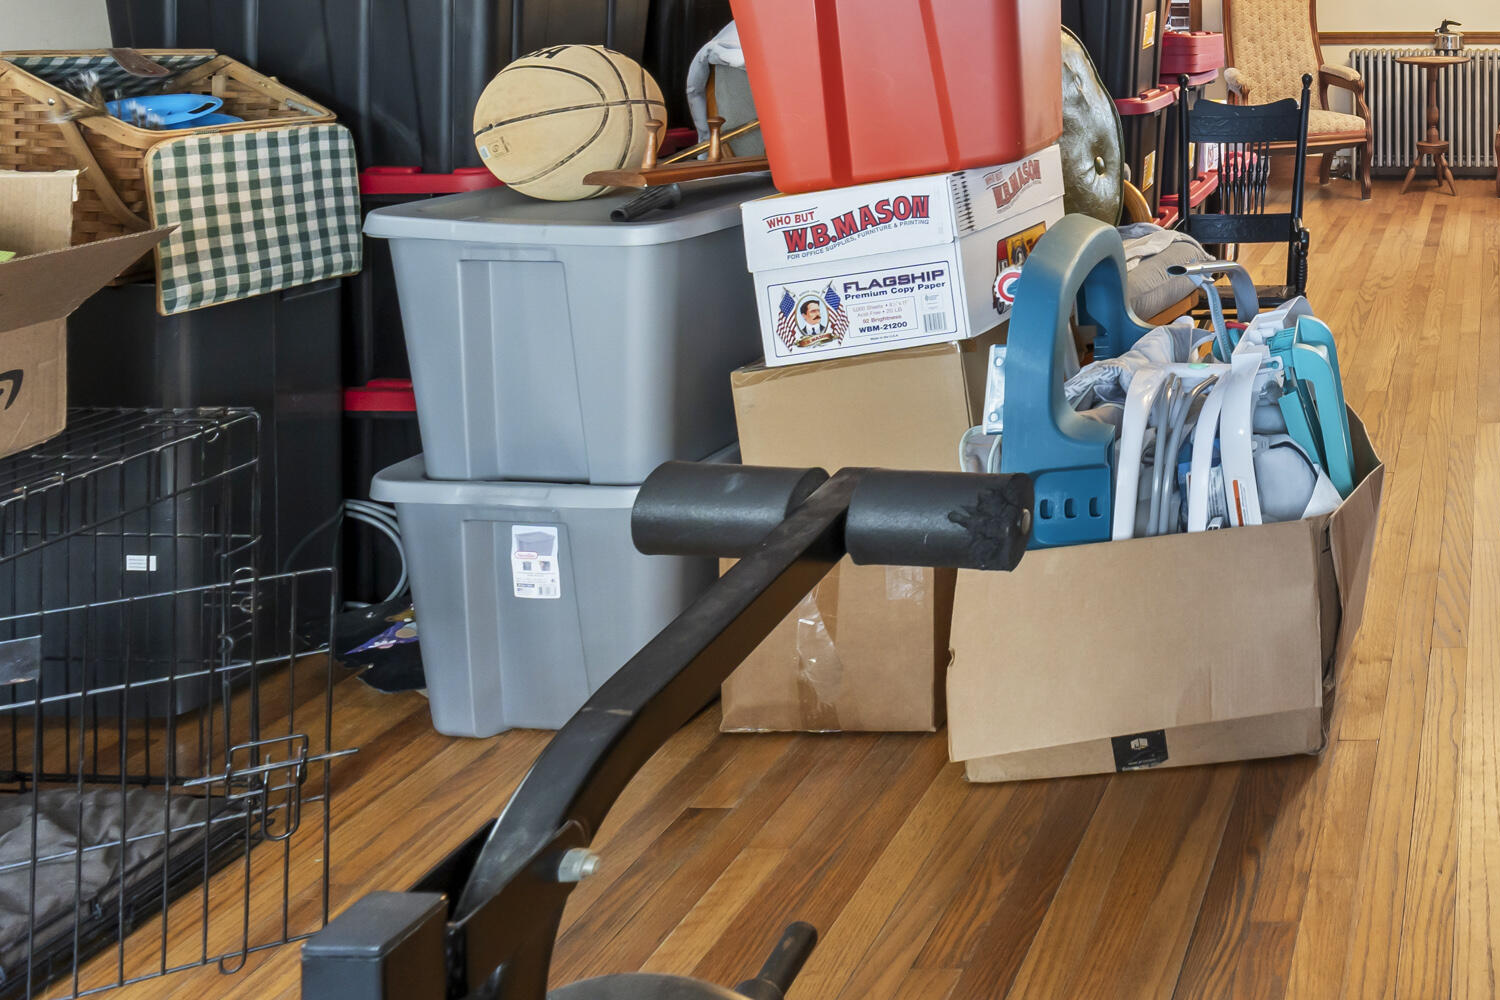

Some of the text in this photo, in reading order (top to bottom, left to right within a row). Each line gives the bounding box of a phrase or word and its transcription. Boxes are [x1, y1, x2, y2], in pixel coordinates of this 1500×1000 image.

[766, 211, 815, 229] WHO BUT
[787, 253, 801, 261] FOR
[801, 248, 825, 258] OFFICE
[857, 225, 892, 239] FURNITURE
[899, 219, 930, 227] PRINTING
[843, 269, 945, 293] FLAGSHIP
[844, 281, 946, 300] Premium Copy Paper
[858, 321, 908, 333] WBM-21200
